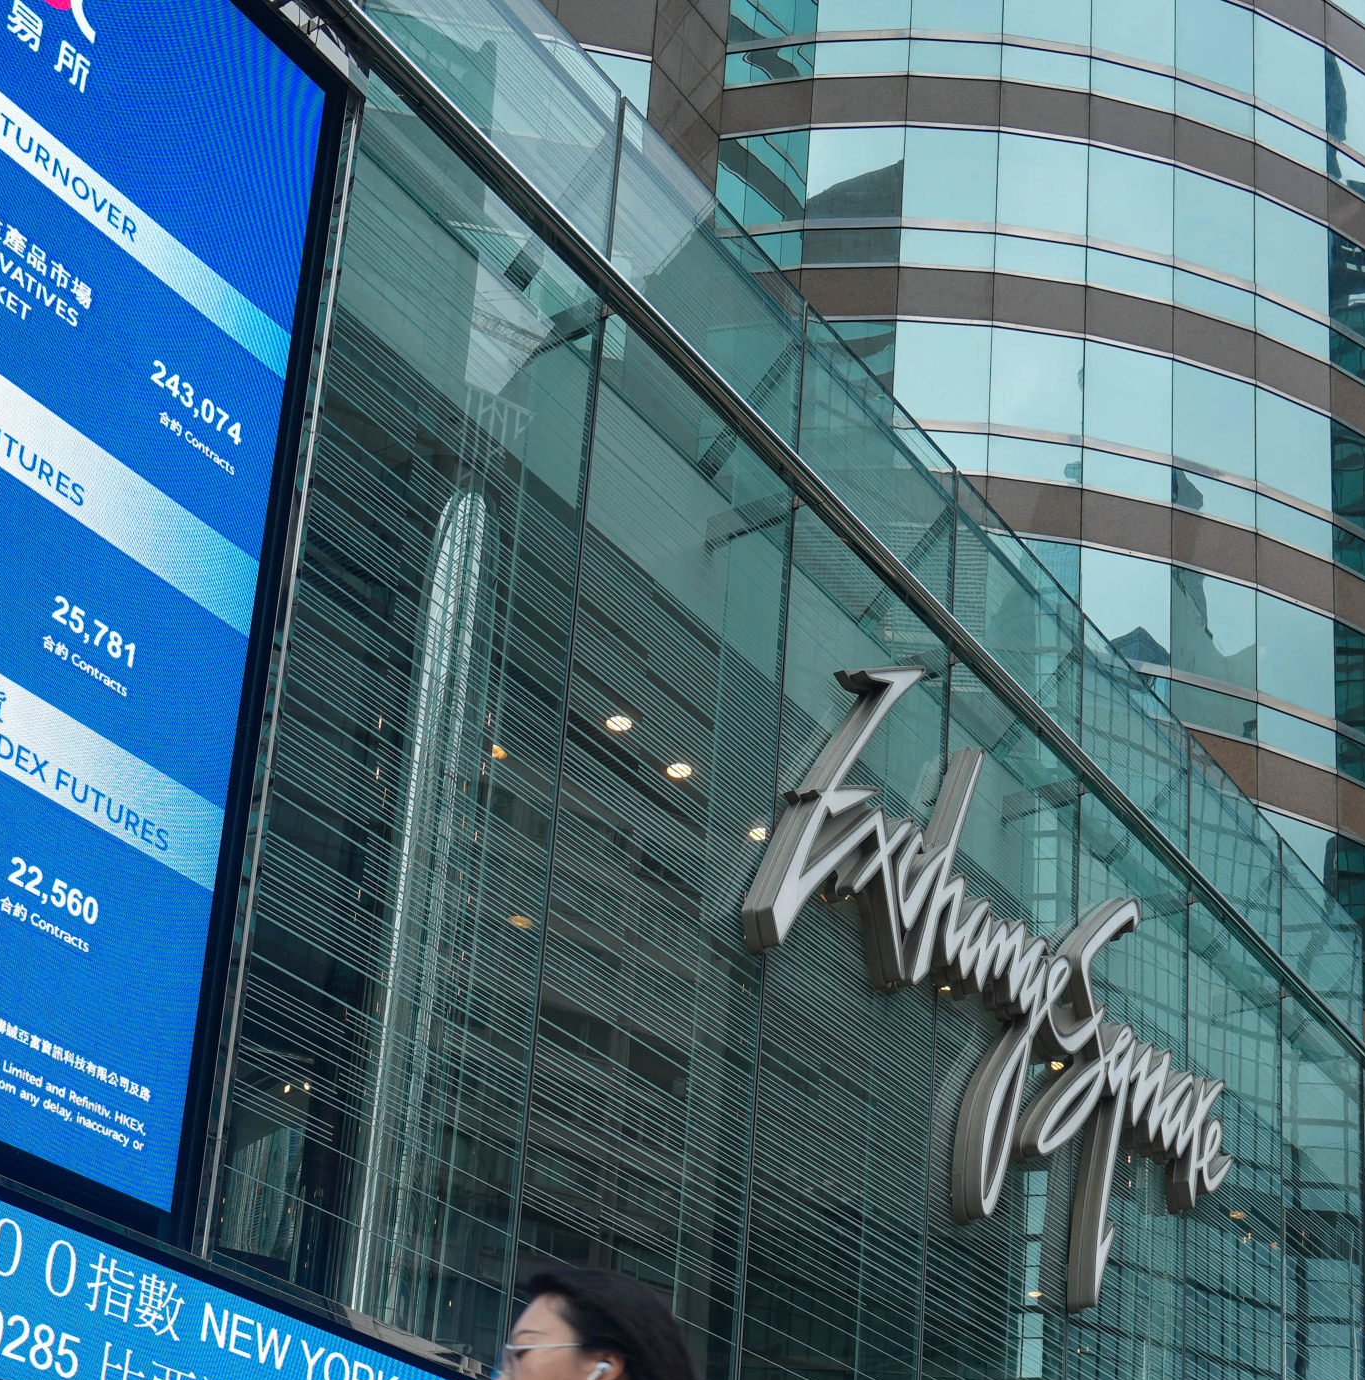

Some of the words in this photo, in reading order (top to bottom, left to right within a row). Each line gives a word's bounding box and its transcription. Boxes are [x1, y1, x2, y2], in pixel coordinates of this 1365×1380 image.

[0, 112, 138, 243] TURNOVER
[150, 359, 243, 447] 243,074
[158, 410, 183, 438] 合約
[185, 430, 236, 476] Contracts
[42, 634, 69, 662] 合約
[71, 651, 128, 698] Contracts
[51, 595, 137, 669] 25,781
[56, 771, 169, 851] FUTURES
[0, 895, 28, 921] 合約
[30, 911, 90, 953] Contracts
[7, 857, 99, 926] 22,560
[3, 1060, 43, 1089] Limited
[76, 1111, 130, 1149] inaccuracy
[200, 1302, 292, 1371] NEW
